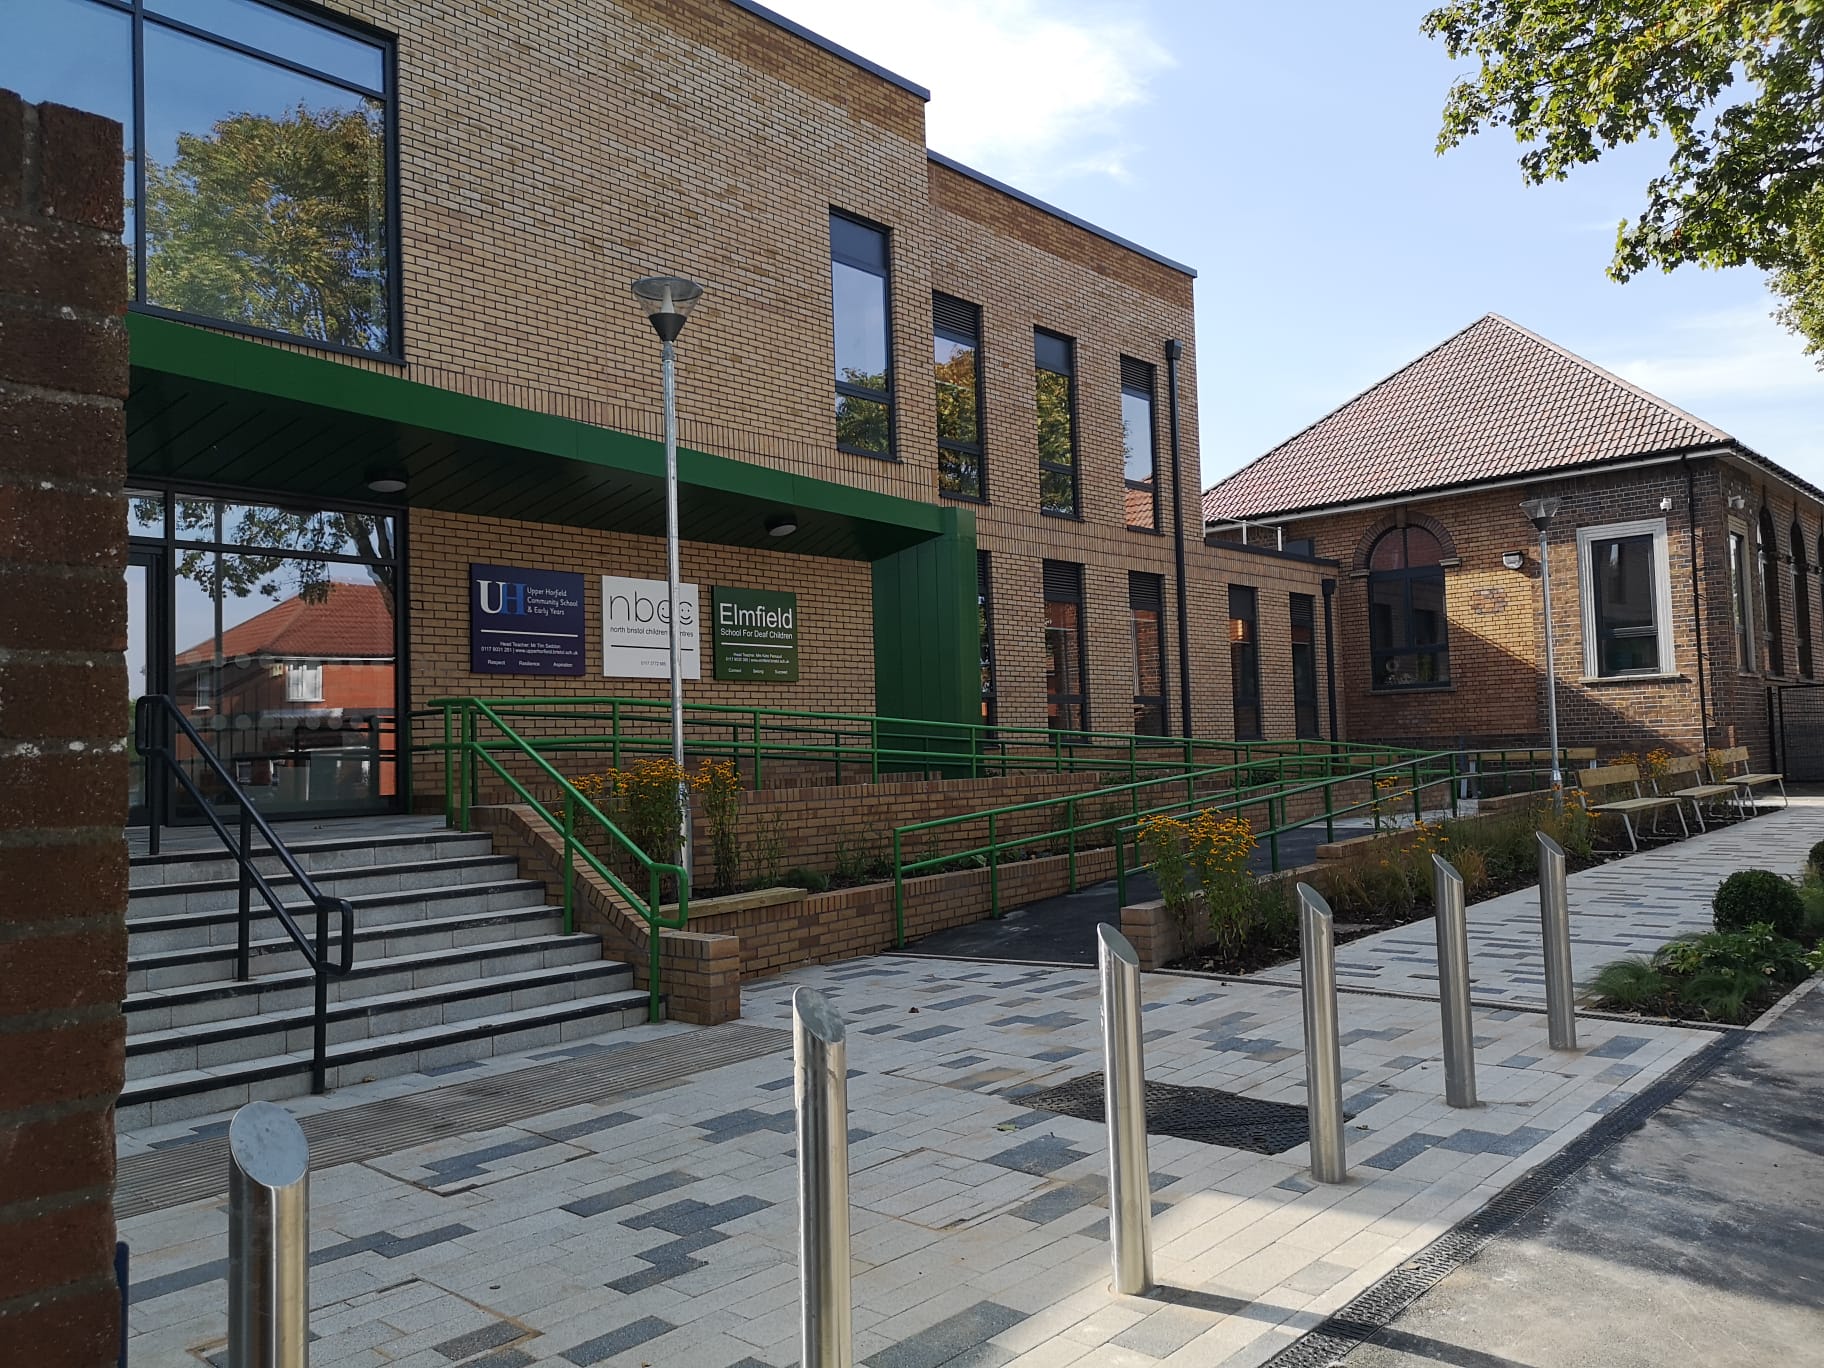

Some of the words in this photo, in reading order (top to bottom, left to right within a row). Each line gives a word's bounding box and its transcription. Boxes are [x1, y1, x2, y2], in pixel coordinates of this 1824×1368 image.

[476, 579, 527, 616] UH
[526, 587, 544, 596] Upper
[545, 588, 567, 598] Horfield
[526, 596, 559, 607] Community
[560, 599, 578, 607] School
[534, 607, 549, 616] Early
[719, 602, 793, 629] Elmfield
[720, 628, 742, 637] School
[754, 630, 768, 638] Deaf
[769, 631, 793, 640] Children
